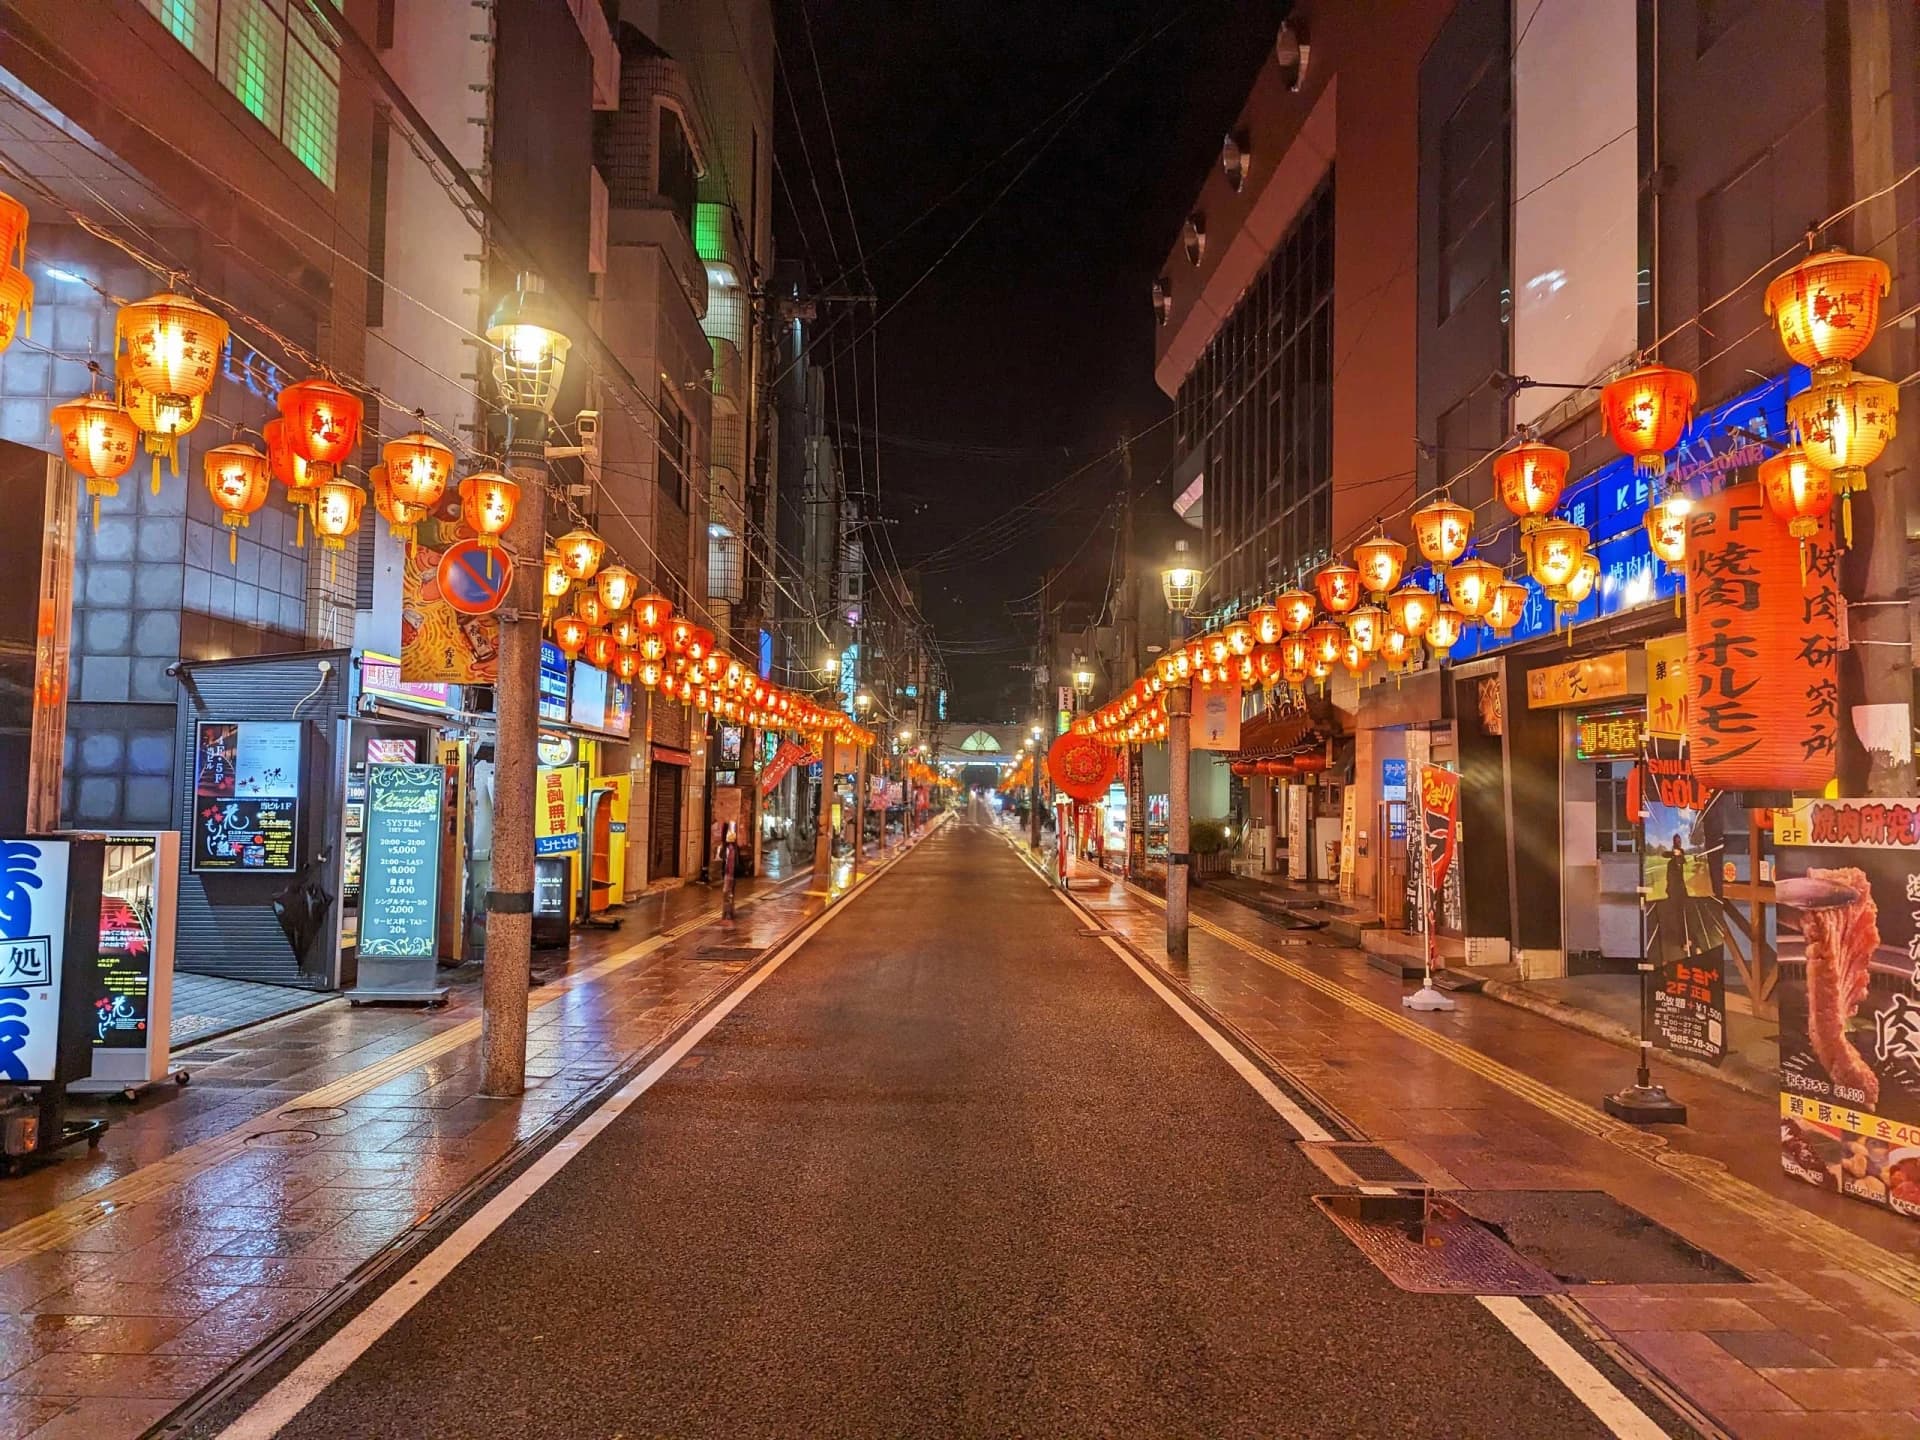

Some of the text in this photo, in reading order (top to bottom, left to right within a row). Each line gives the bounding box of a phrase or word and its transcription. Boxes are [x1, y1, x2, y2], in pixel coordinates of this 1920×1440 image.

[1690, 505, 1764, 539] 2F
[1782, 829, 1802, 842] 2F
[1811, 803, 1920, 846] 焼肉研究
